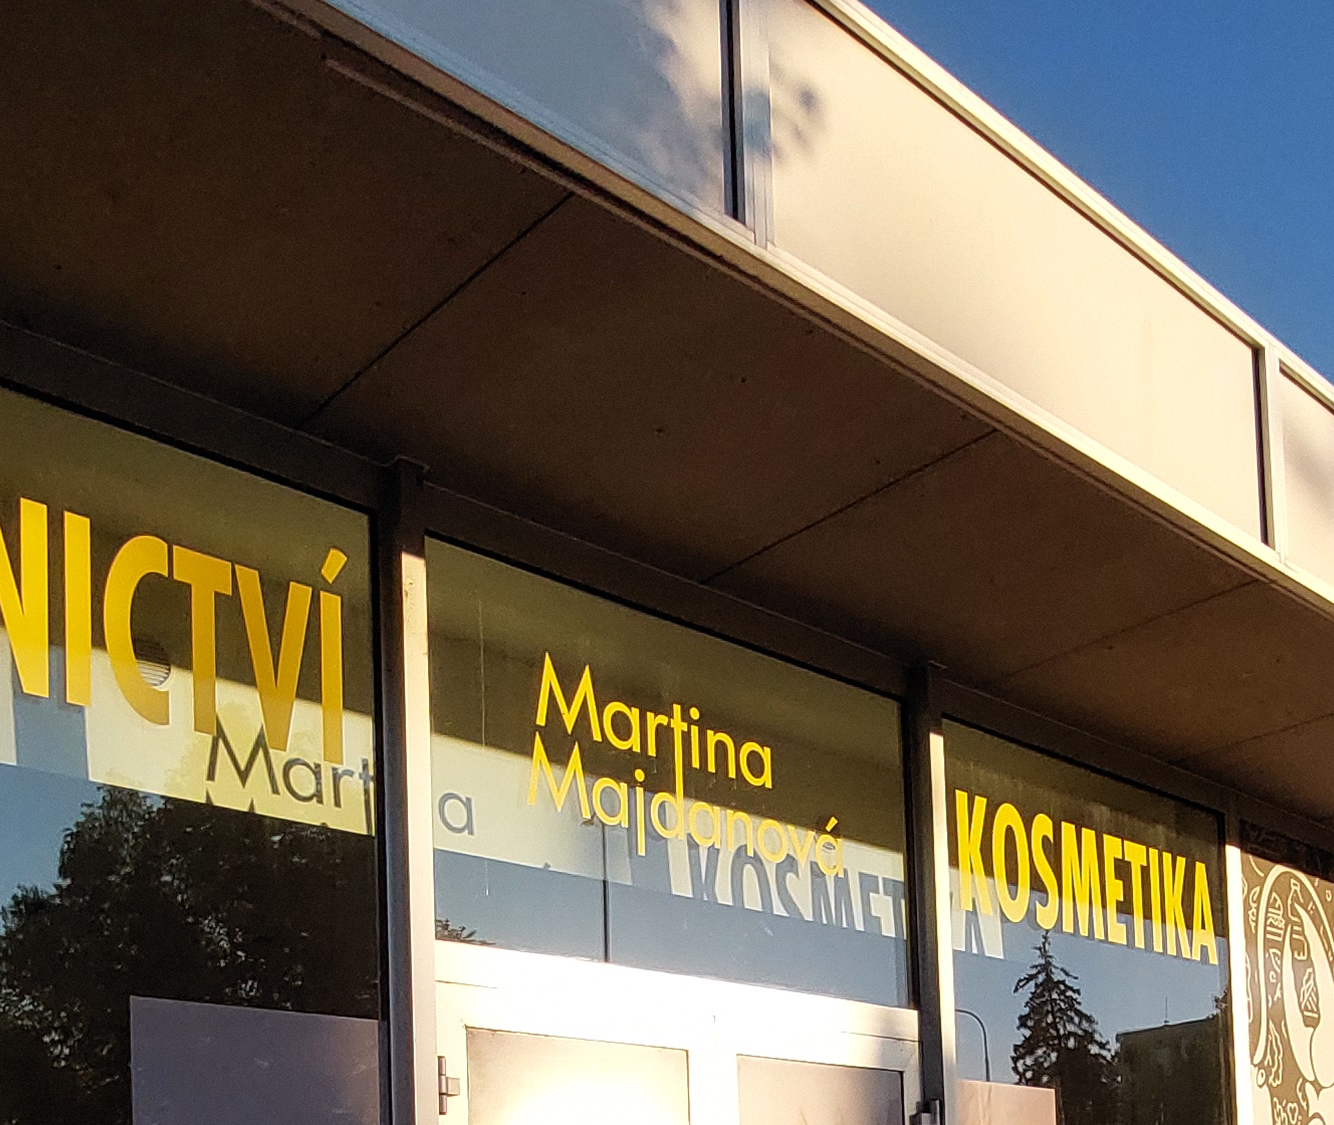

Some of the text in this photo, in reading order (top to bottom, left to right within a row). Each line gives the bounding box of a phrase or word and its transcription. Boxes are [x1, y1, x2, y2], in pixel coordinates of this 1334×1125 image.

[535, 651, 772, 789] Martina
[527, 731, 844, 877] Majdanová
[955, 789, 1218, 964] KOSMETIKA
